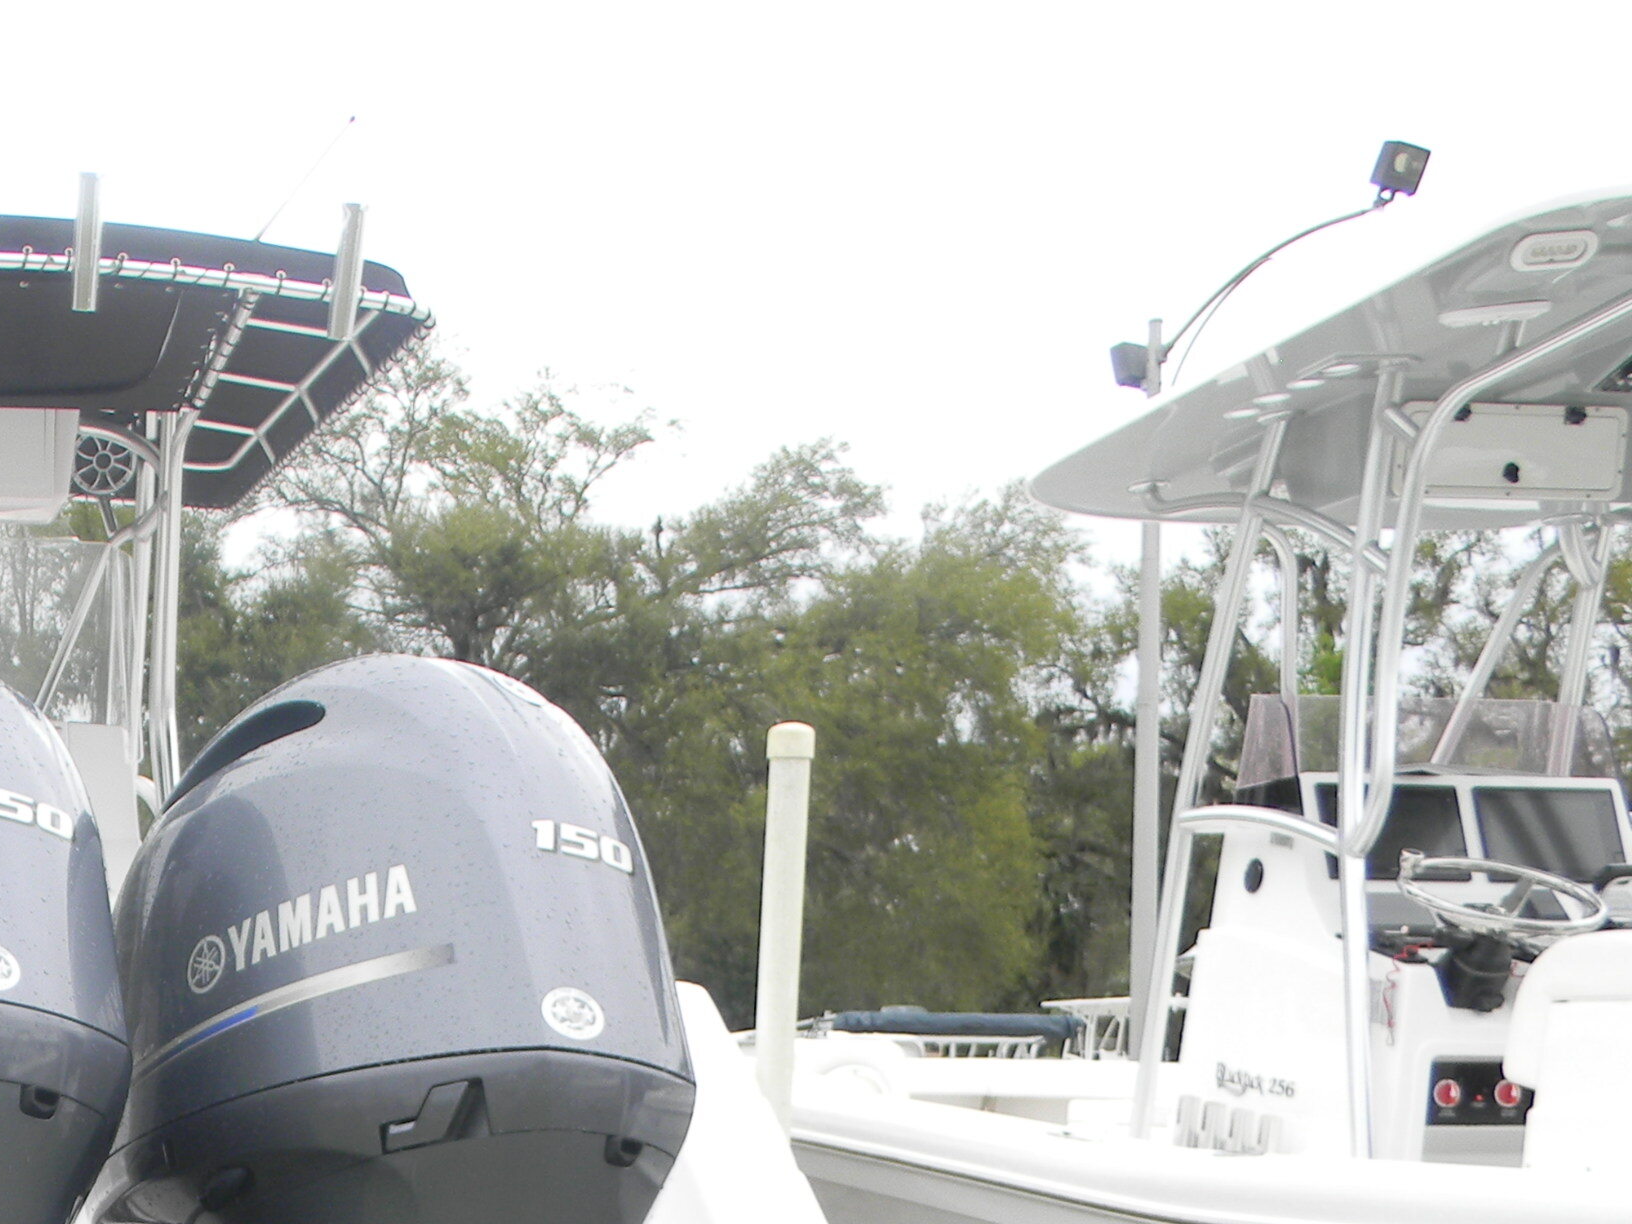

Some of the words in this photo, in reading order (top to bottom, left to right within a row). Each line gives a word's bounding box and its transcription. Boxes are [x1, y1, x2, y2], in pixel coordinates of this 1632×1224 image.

[531, 819, 634, 875] 150
[227, 864, 417, 972] YAMAHA
[1269, 1077, 1295, 1097] 256
